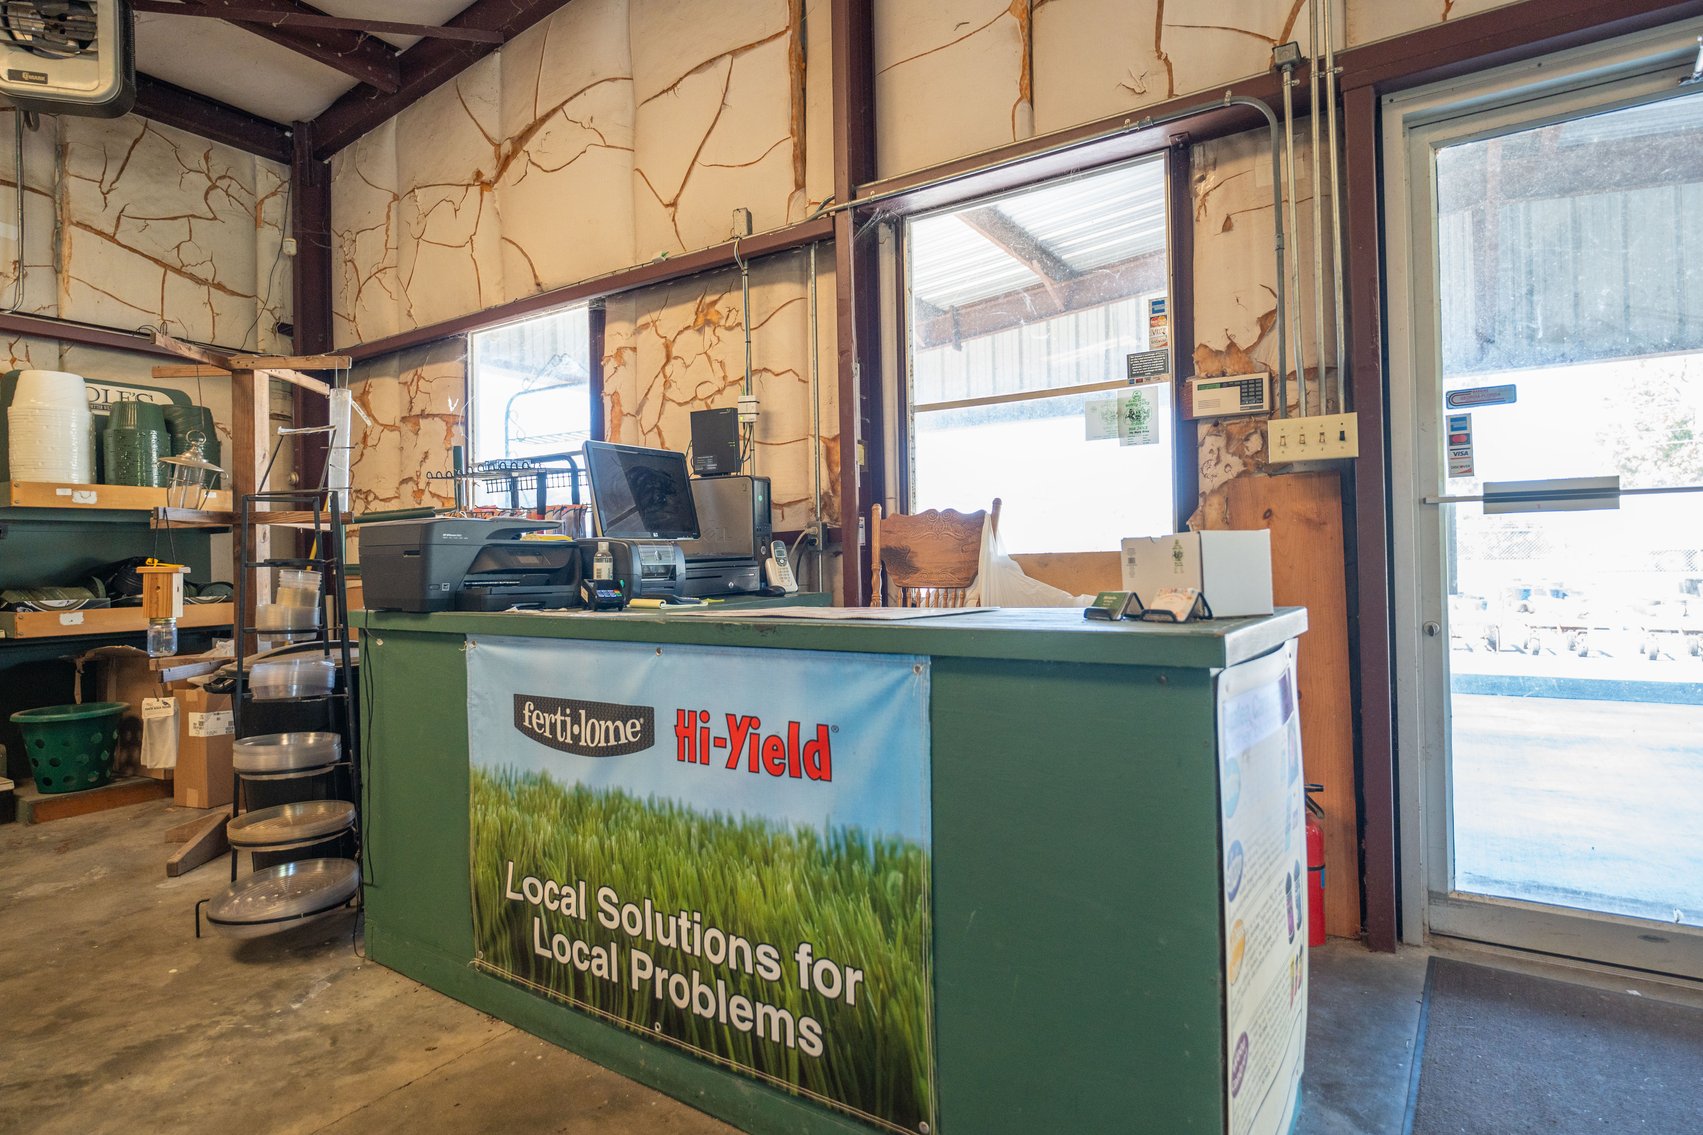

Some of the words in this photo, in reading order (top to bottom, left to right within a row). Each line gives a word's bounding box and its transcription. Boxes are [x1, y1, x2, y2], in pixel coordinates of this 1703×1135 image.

[505, 860, 587, 921] Local
[597, 886, 782, 981] Solutions
[794, 941, 864, 1006] for
[533, 916, 619, 983] Local
[631, 948, 824, 1057] Problems
